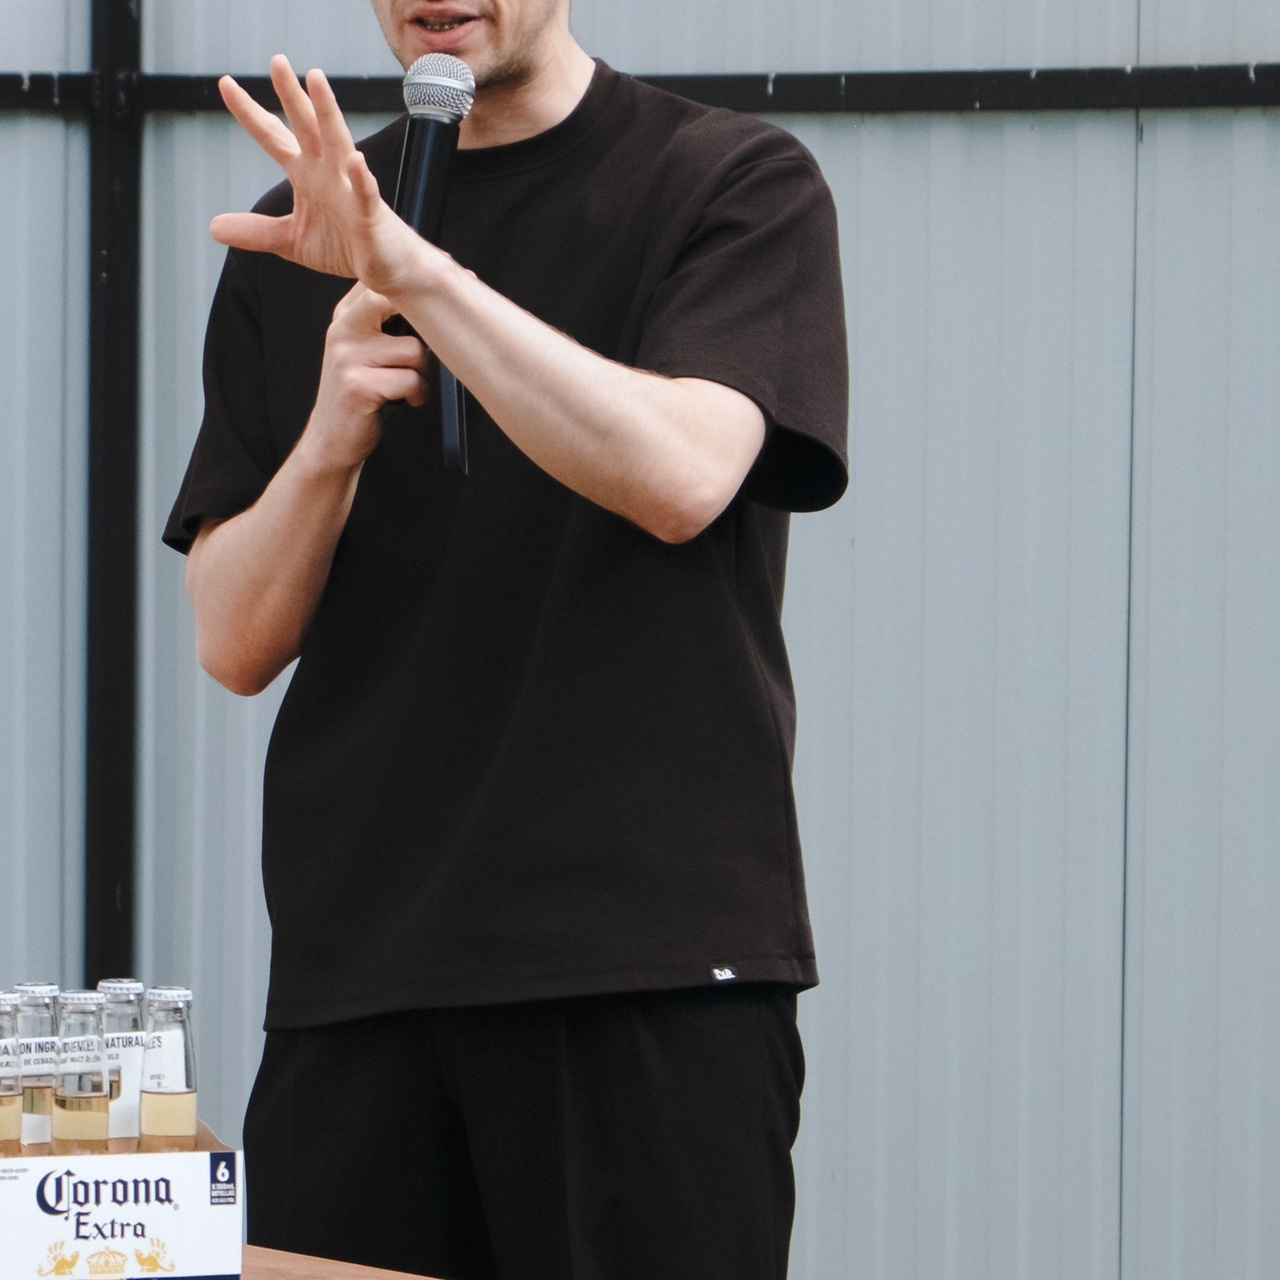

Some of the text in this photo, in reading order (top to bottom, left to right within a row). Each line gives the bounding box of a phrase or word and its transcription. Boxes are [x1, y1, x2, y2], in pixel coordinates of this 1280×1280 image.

[216, 1161, 230, 1182] 6
[36, 1169, 174, 1221] Corona
[74, 1211, 146, 1240] Extra
